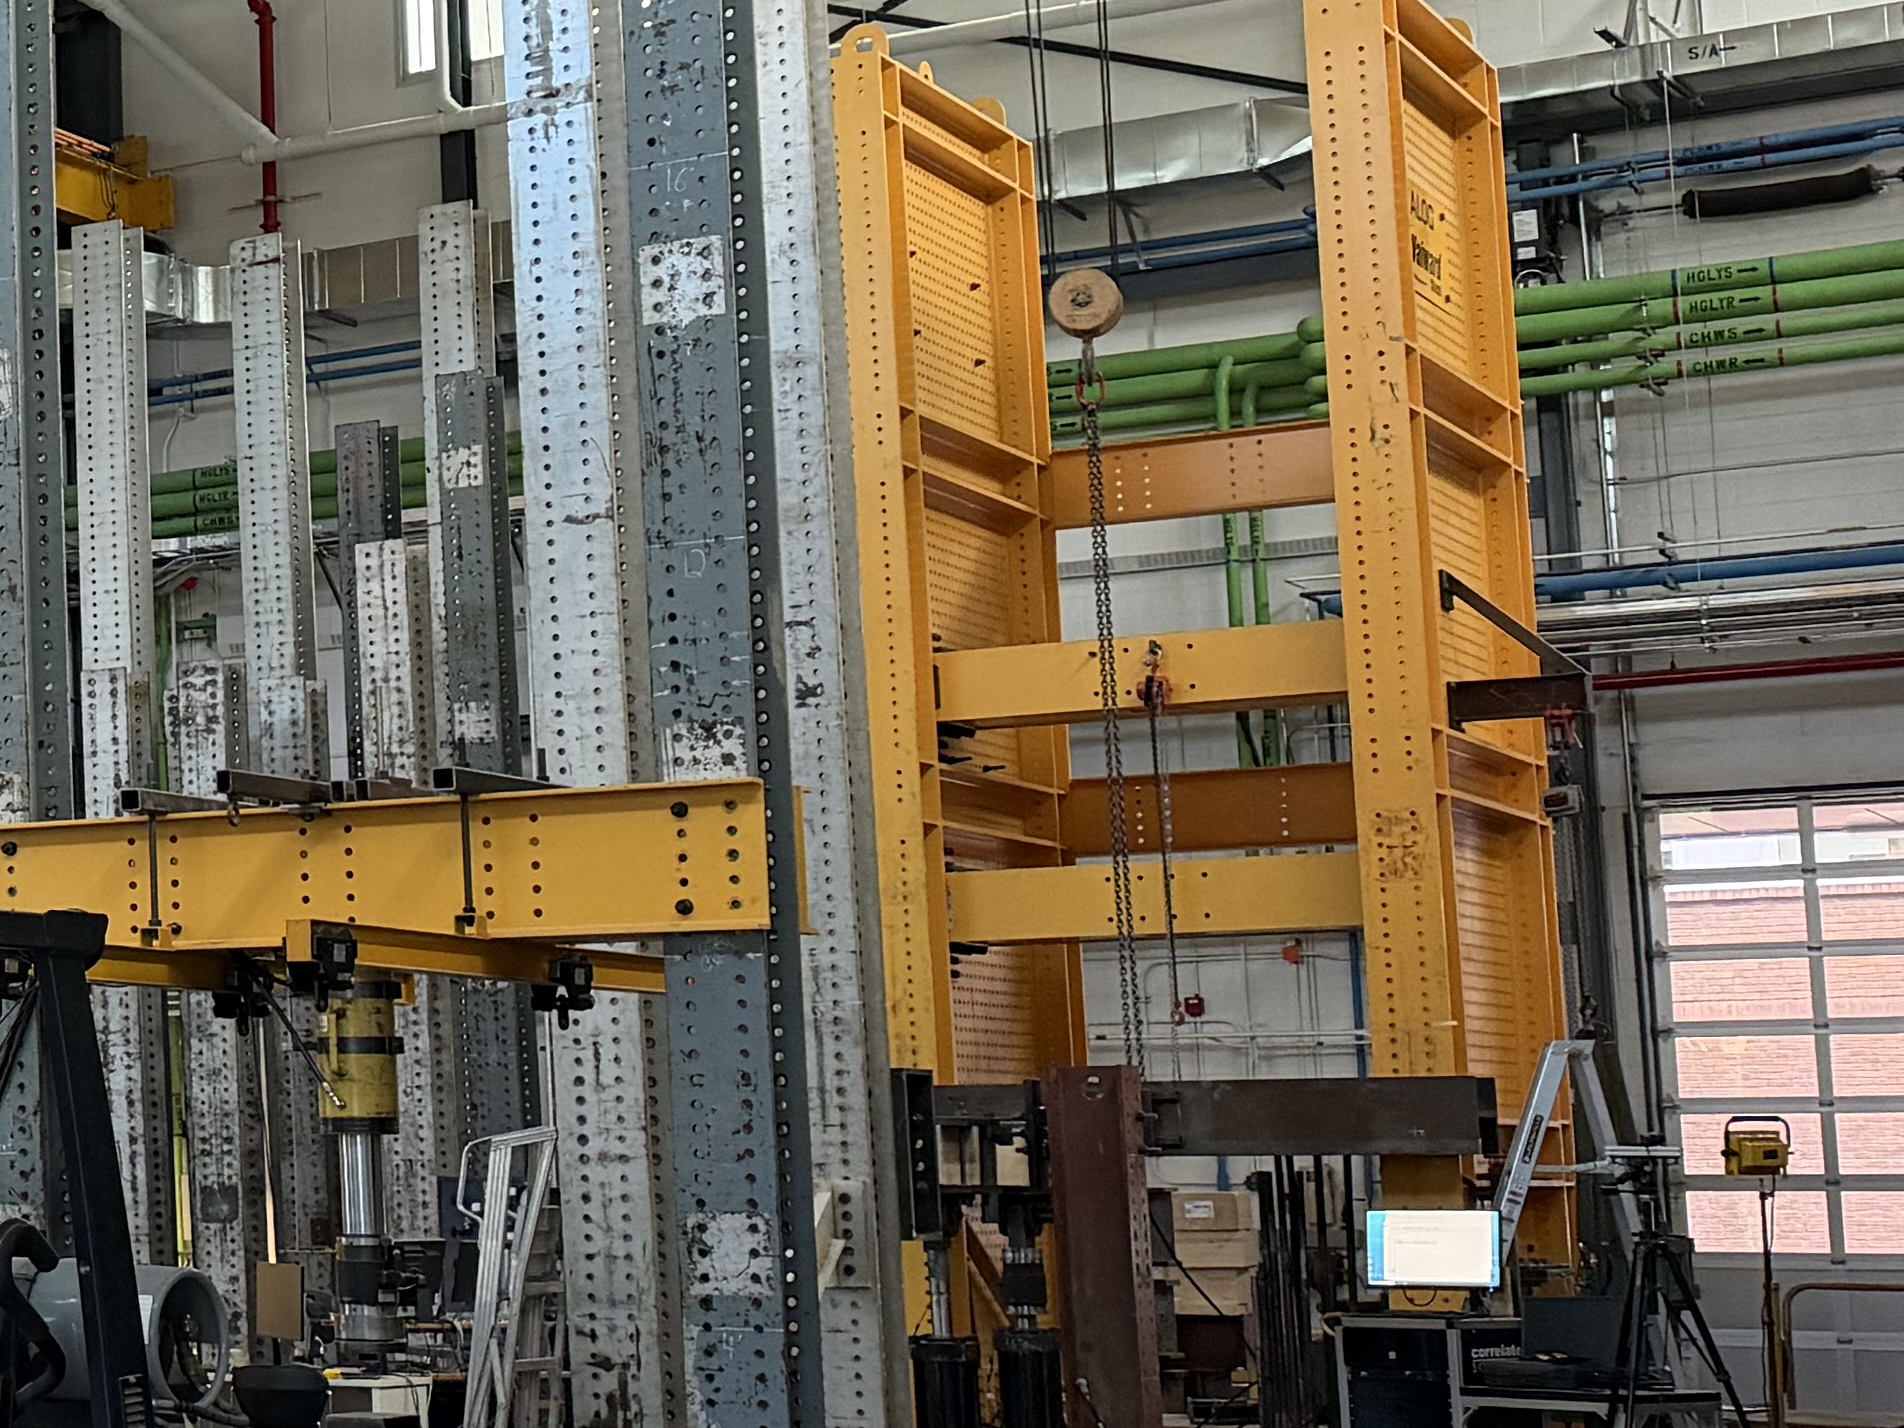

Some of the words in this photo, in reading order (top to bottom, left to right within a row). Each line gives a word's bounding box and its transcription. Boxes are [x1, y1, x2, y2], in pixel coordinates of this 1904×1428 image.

[1686, 266, 1734, 284] HGLYS
[1689, 297, 1737, 315] HGLYR
[1689, 326, 1739, 345] CHWS
[1692, 356, 1740, 373] CHWR
